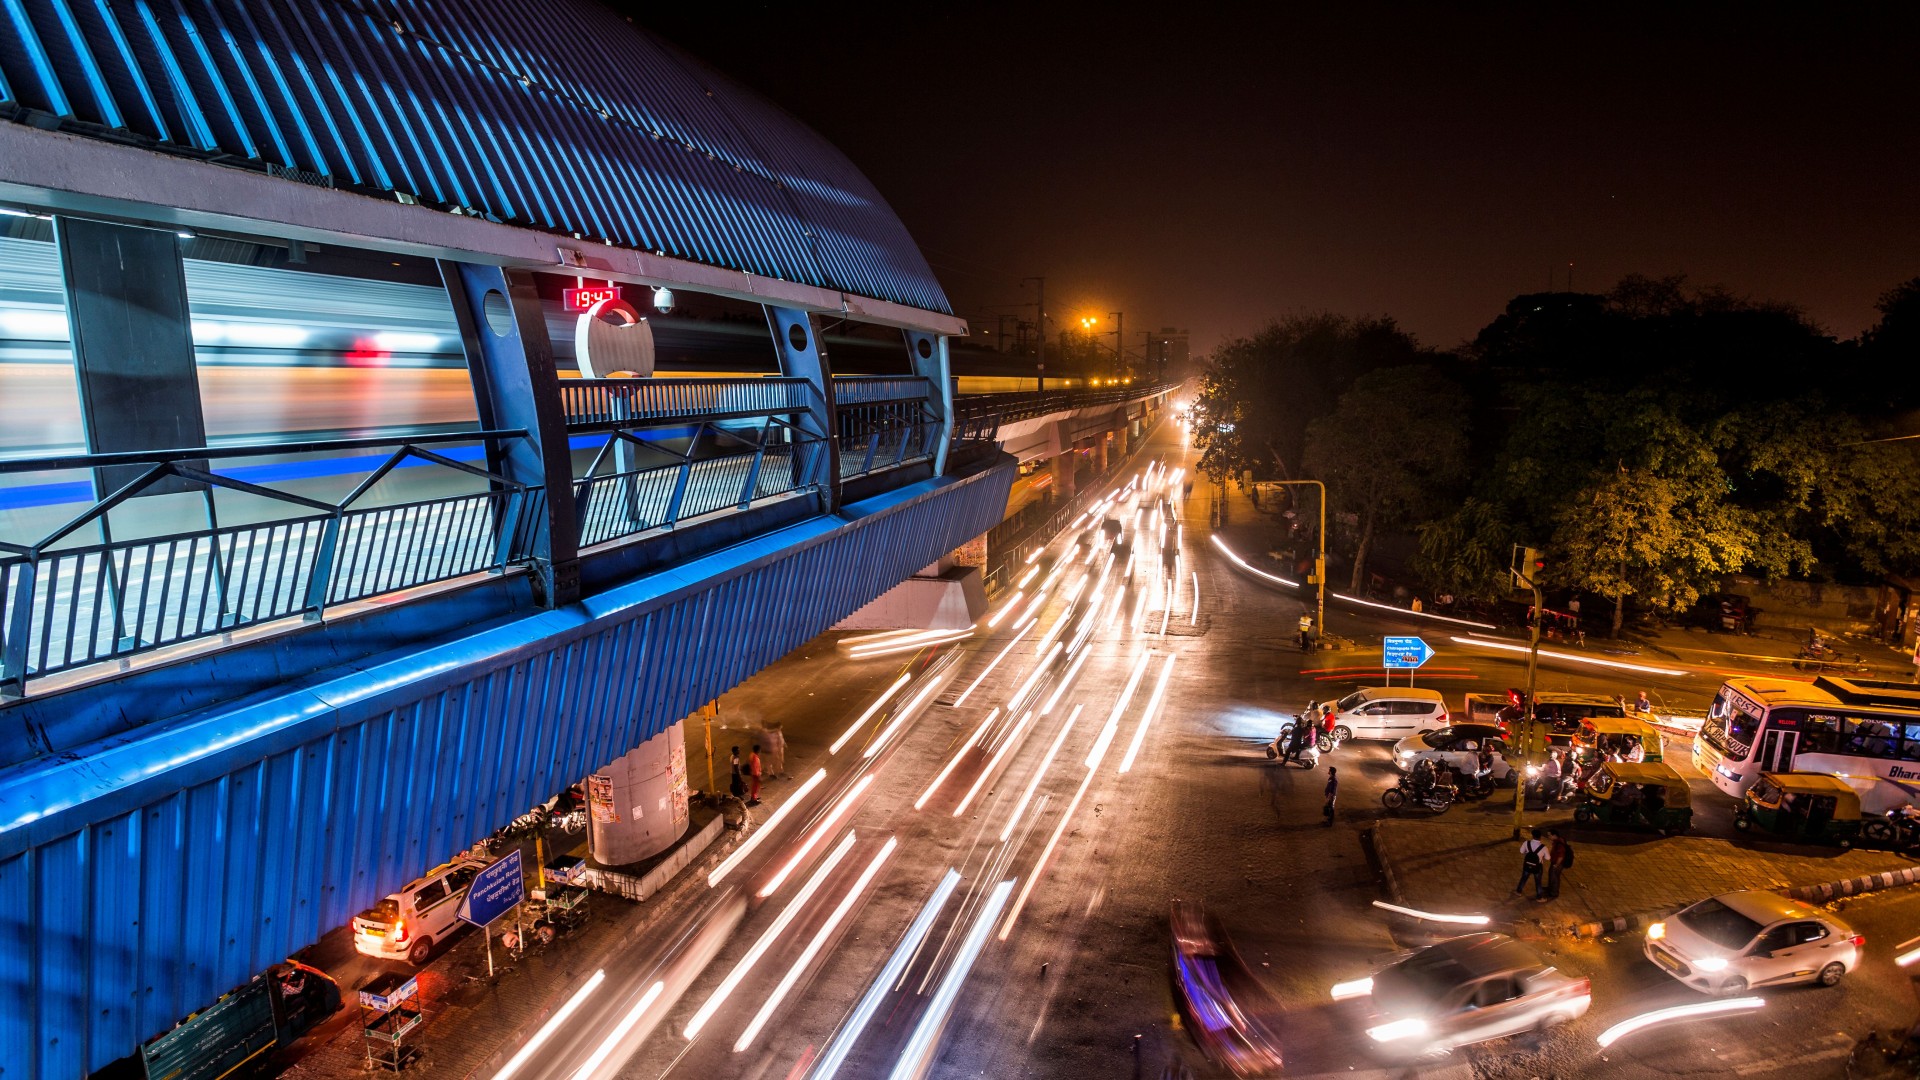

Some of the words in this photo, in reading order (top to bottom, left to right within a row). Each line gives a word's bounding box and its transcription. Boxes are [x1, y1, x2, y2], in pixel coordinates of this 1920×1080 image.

[576, 291, 613, 307] 19:47
[473, 876, 505, 900] Panchkuian
[505, 865, 520, 879] Road
